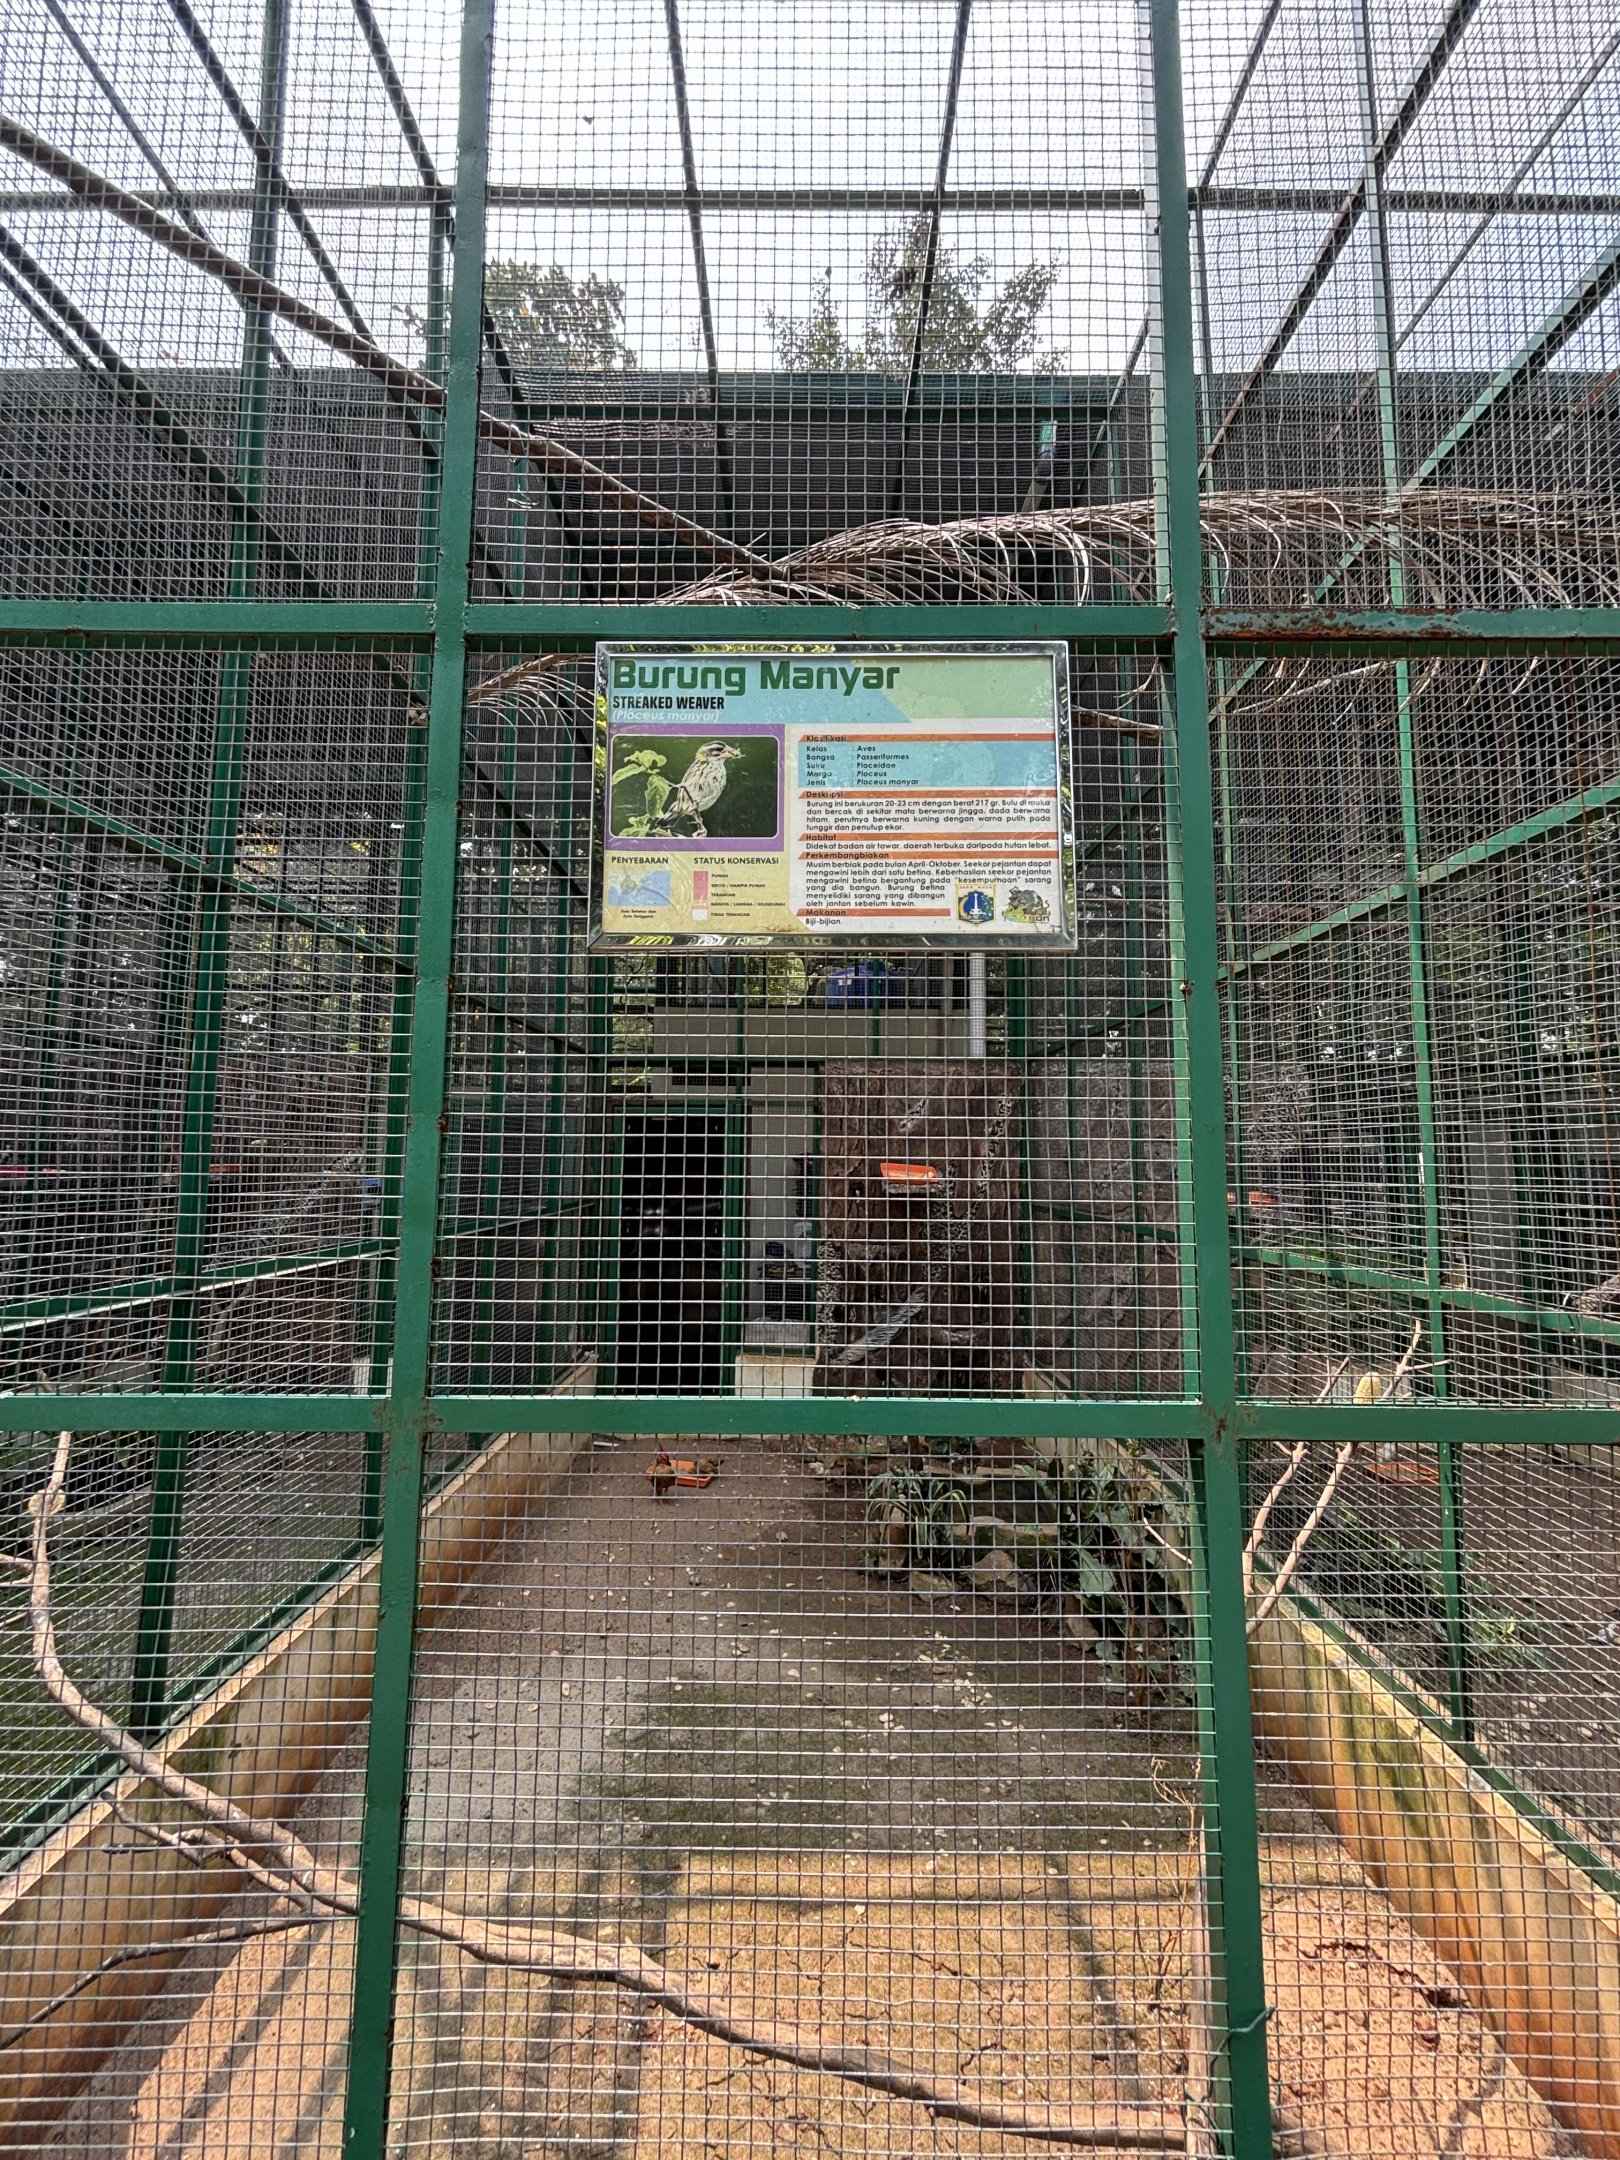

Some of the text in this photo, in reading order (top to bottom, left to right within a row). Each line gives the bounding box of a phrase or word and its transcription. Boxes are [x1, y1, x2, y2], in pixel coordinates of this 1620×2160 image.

[614, 660, 900, 696] Burung Manyar
[613, 696, 724, 709] STREAKED WEAVER
[612, 710, 720, 722] (Ploceus manyar)
[806, 892, 850, 900] menyelidiki
[908, 892, 945, 900] dibangun
